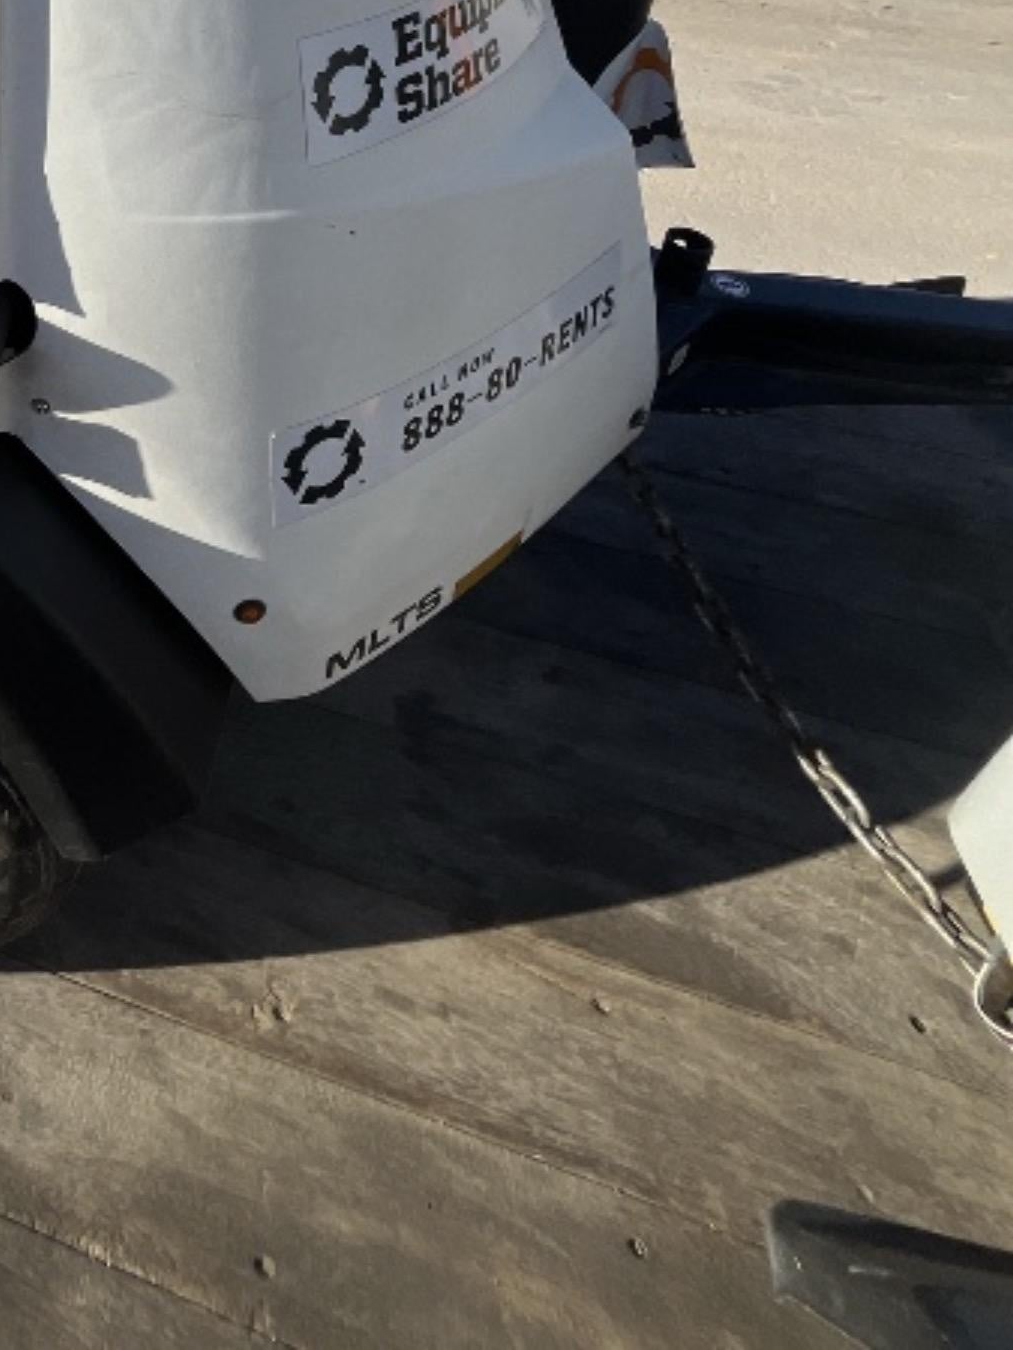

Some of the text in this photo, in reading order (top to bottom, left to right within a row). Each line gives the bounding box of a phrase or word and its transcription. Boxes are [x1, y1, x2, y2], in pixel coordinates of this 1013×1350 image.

[395, 37, 501, 124] Share
[401, 284, 616, 453] 888-80-RENTS
[325, 585, 444, 679] MLTS
